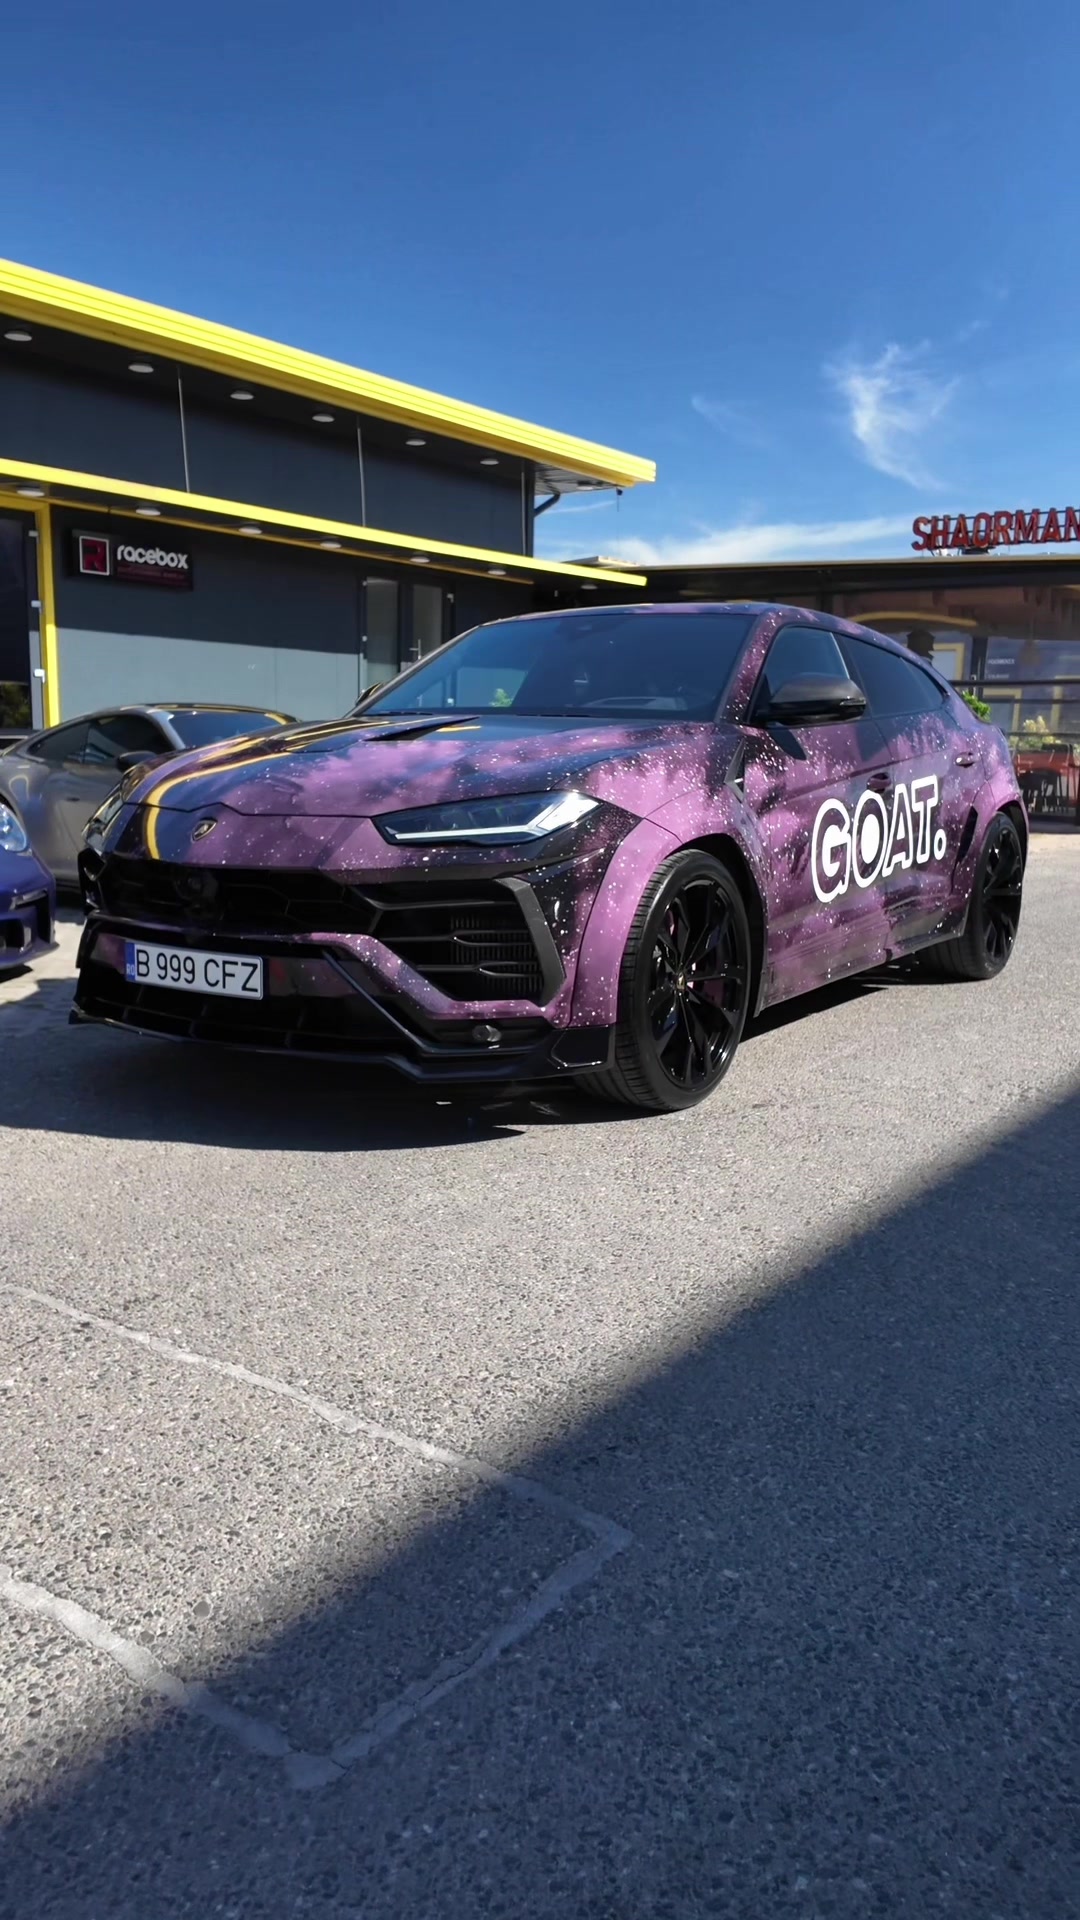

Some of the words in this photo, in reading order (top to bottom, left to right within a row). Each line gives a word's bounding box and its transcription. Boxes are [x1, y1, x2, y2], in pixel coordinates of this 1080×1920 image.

[116, 545, 189, 570] racebox
[811, 774, 947, 903] GOAT.
[126, 963, 135, 976] RO
[136, 949, 150, 977] B
[156, 952, 196, 984] 999
[204, 959, 258, 993] CFZ
